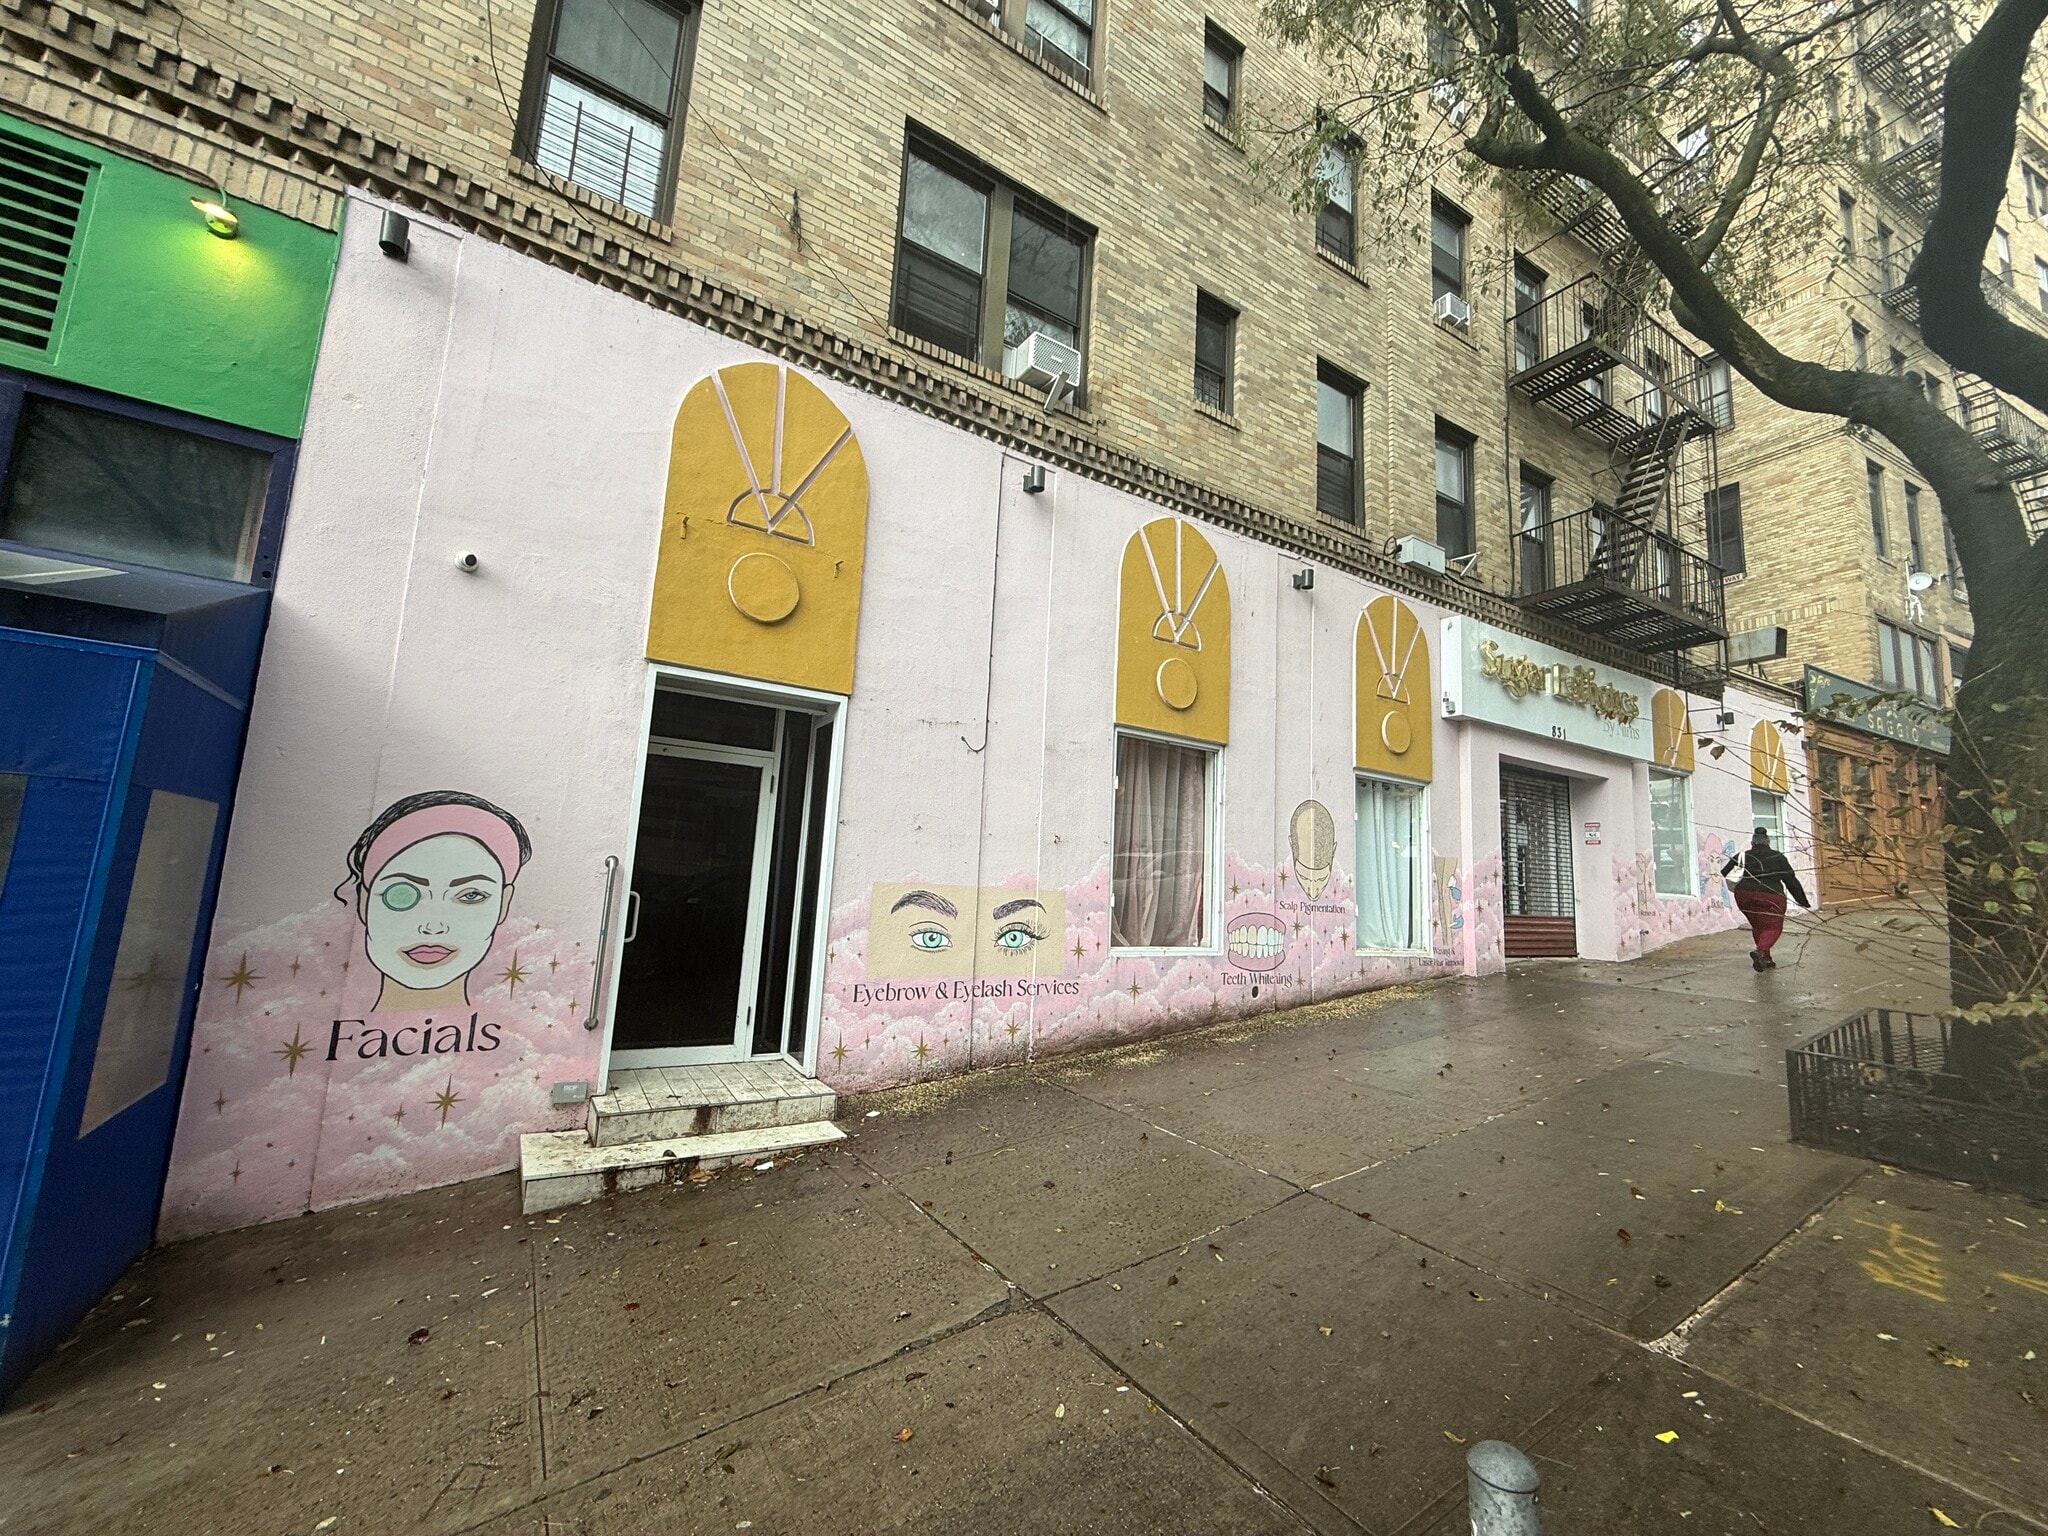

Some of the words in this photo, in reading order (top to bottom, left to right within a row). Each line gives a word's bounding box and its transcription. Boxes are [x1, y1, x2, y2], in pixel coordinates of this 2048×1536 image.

[1480, 639, 1551, 699] Sugar
[1551, 725, 1567, 740] 831
[1867, 713, 1919, 742] SAGGIO
[1279, 900, 1298, 913] Scalp
[1300, 901, 1346, 915] Pigmentation
[853, 983, 931, 1006] Eyebrow
[935, 981, 948, 999] &
[953, 979, 1013, 1003] Eyelash
[1016, 978, 1080, 997] Services
[1221, 972, 1247, 986] Teeth
[1249, 972, 1293, 988] Whitening
[325, 1011, 502, 1061] Facials
